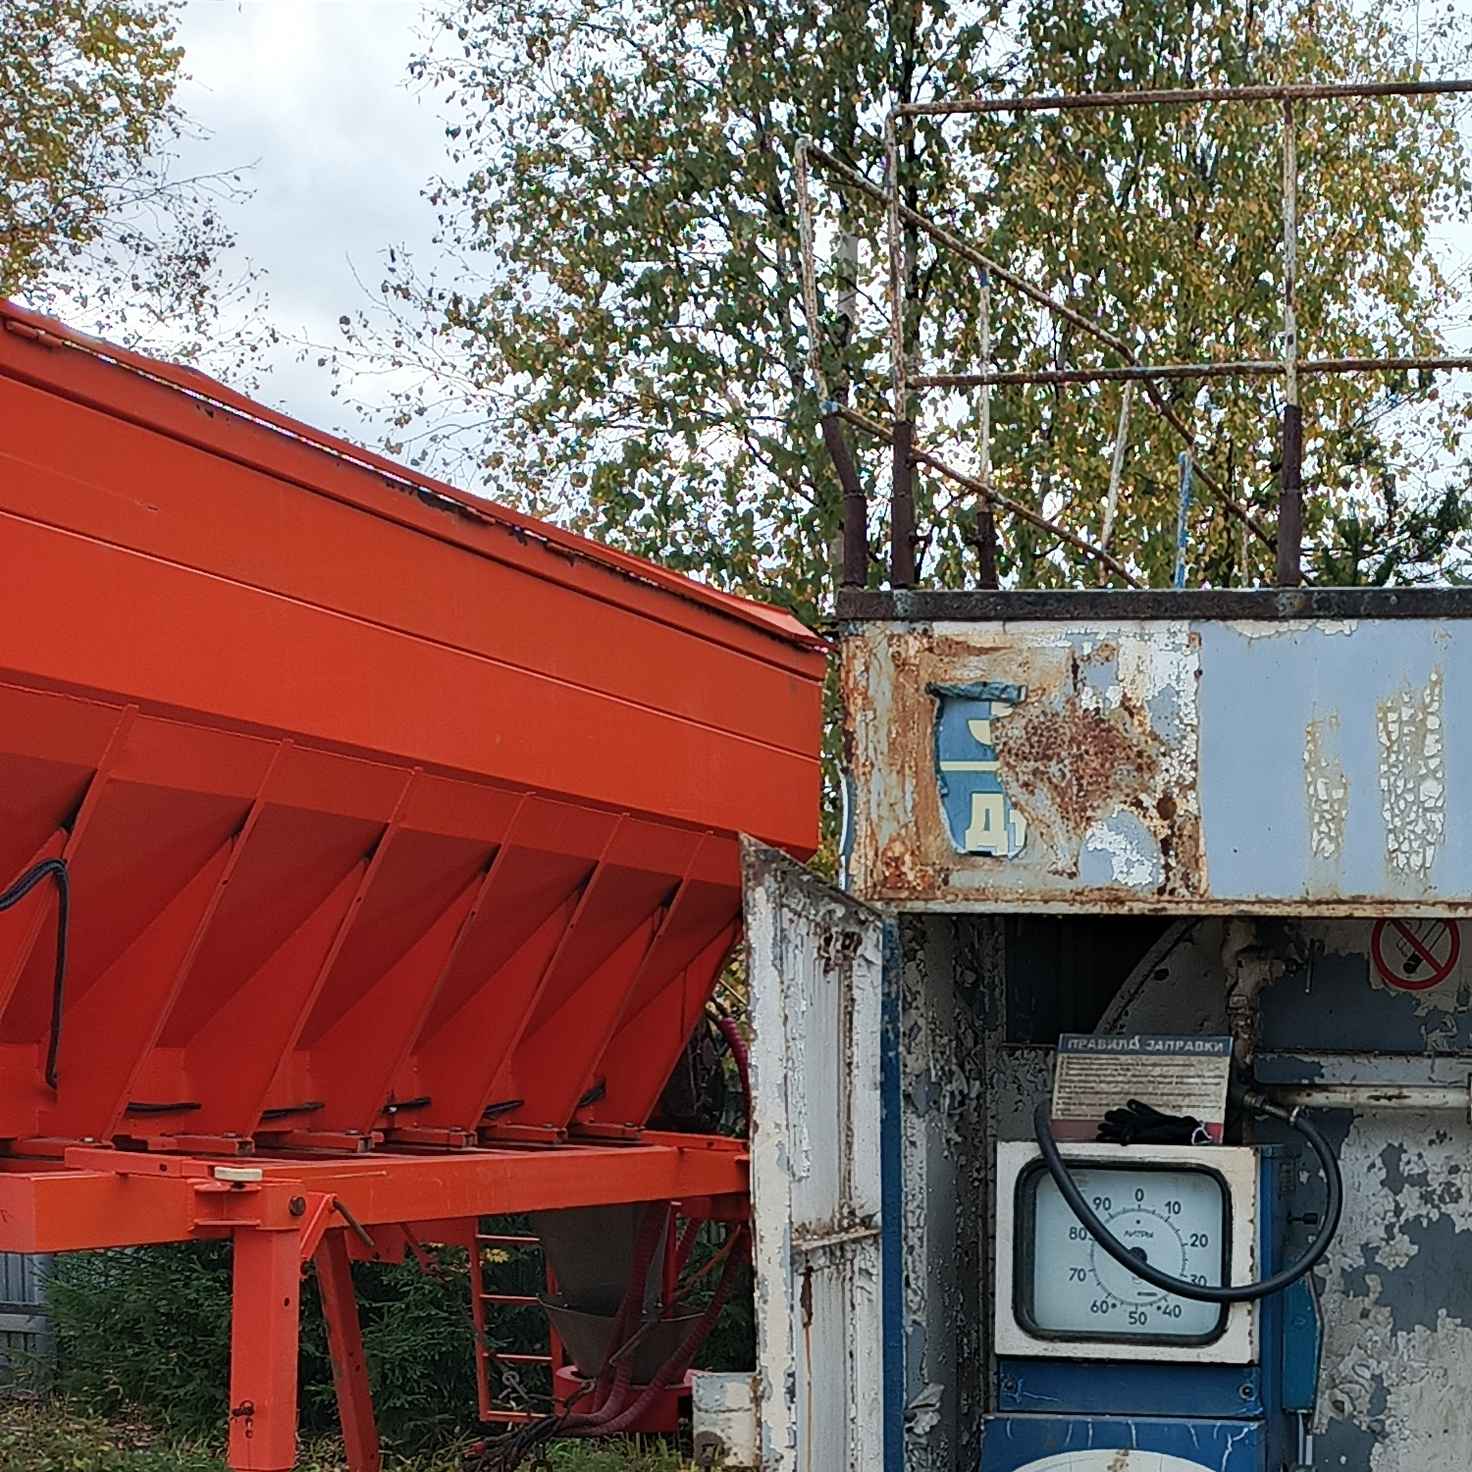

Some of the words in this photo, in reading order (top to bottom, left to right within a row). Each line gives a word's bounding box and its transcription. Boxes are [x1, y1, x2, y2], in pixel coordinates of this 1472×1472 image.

[1067, 1037, 1140, 1050] ПРАВИЛА
[1145, 1040, 1223, 1052] ЗАПРАВКИ
[1135, 1188, 1144, 1202] 0
[1093, 1197, 1111, 1211] 90
[1165, 1201, 1181, 1215] 10
[1068, 1227, 1088, 1241] 80
[1190, 1233, 1209, 1248] 20
[1068, 1268, 1087, 1282] 70
[1190, 1274, 1207, 1287] 30
[1090, 1300, 1109, 1314] 60
[1162, 1305, 1182, 1319] 40
[1128, 1311, 1148, 1326] 50
